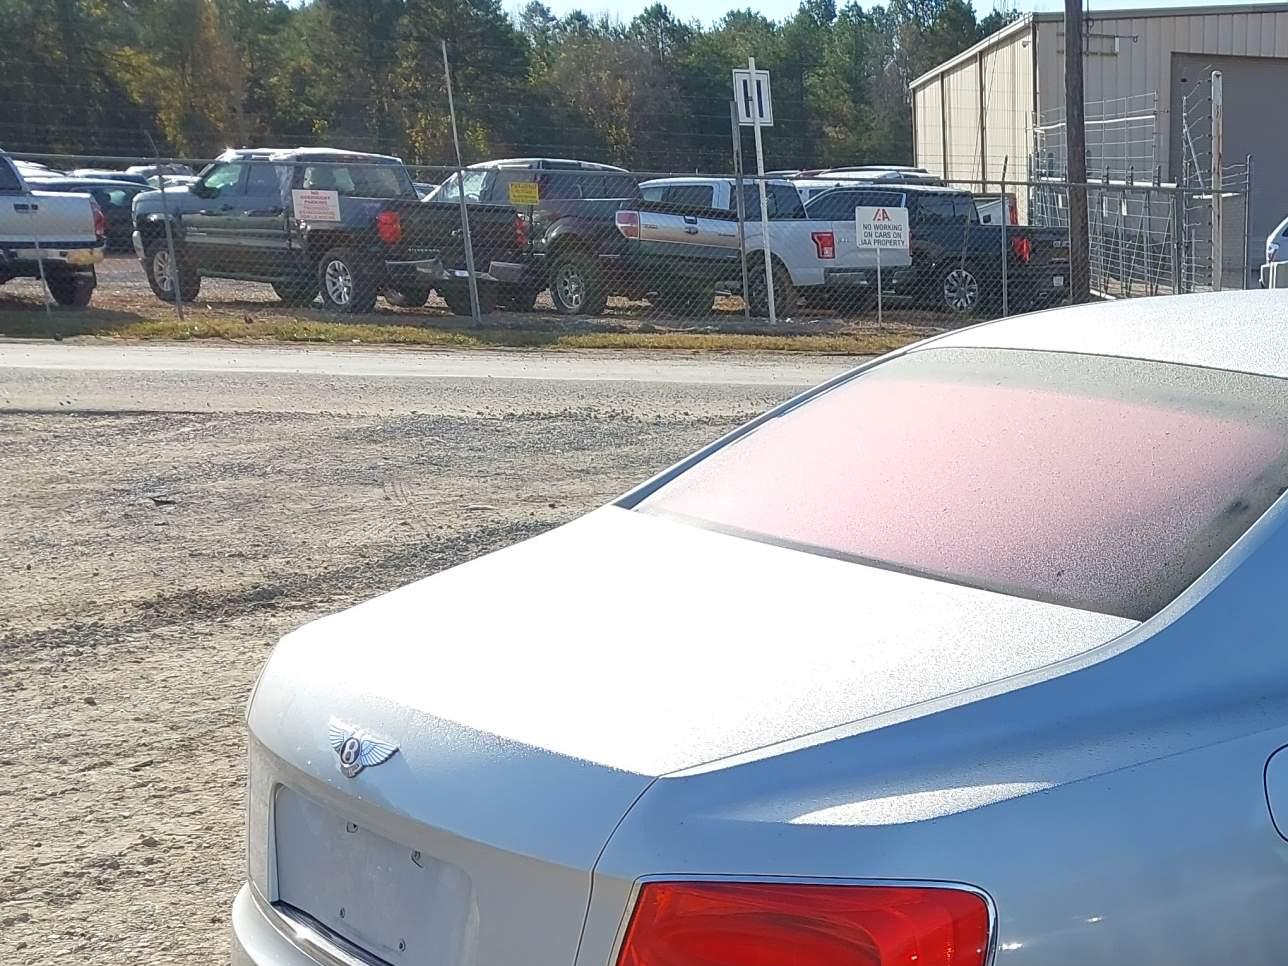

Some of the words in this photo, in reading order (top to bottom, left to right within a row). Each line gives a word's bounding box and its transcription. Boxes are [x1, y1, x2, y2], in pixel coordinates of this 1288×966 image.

[862, 223, 872, 231] NO
[873, 223, 903, 231] WORKING
[863, 231, 873, 239] ON
[875, 231, 892, 239] CARS
[893, 231, 902, 240] ON
[873, 239, 905, 247] PROPERTY
